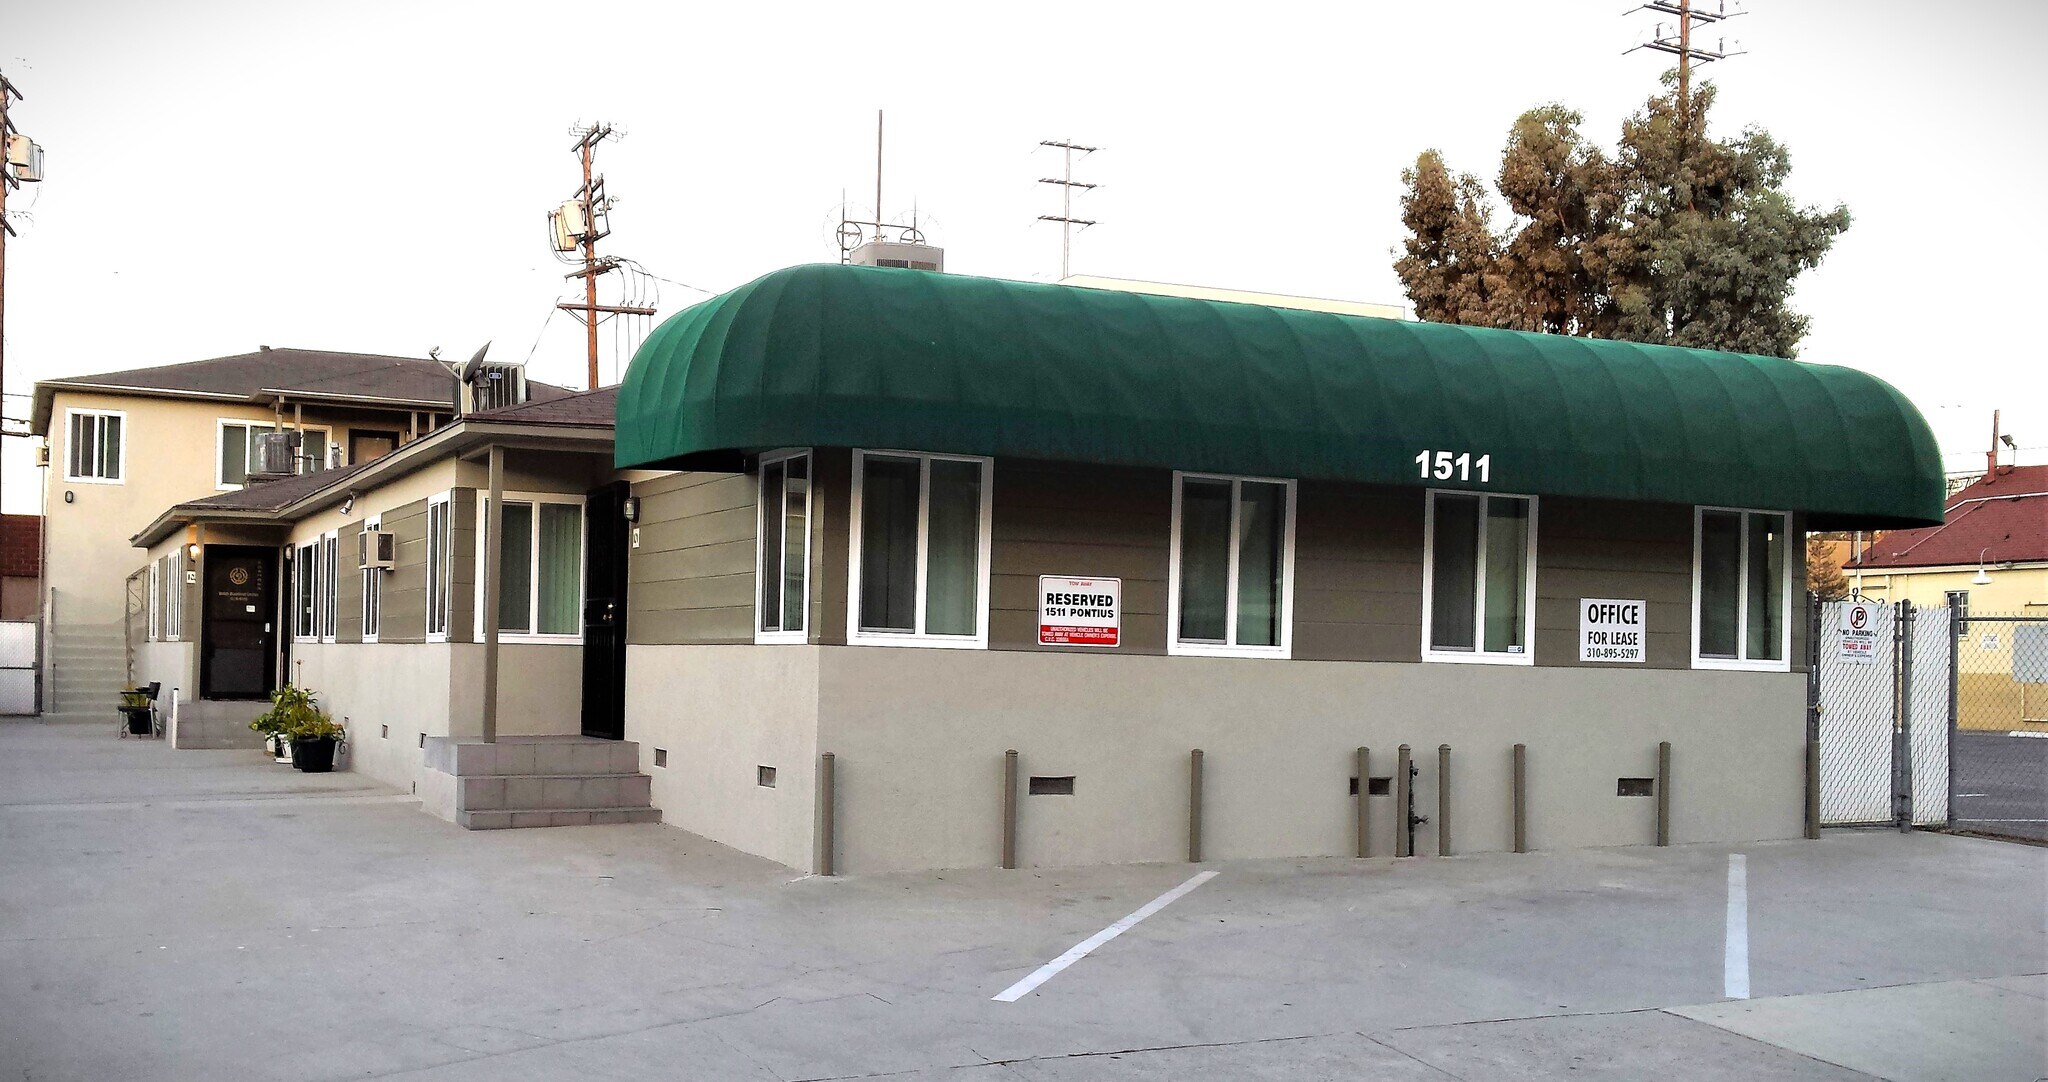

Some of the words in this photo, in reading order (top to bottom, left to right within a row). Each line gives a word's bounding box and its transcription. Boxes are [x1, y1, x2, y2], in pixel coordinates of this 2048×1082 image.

[1415, 450, 1490, 483] 1511
[1046, 593, 1113, 607] RESERVED
[1045, 607, 1066, 617] 1511
[1070, 608, 1114, 618] PONTIUS
[1588, 603, 1639, 625] OFFICE
[1588, 631, 1608, 645] FOR
[1611, 631, 1638, 646] LEASE
[1586, 647, 1639, 659] 310-895-5297
